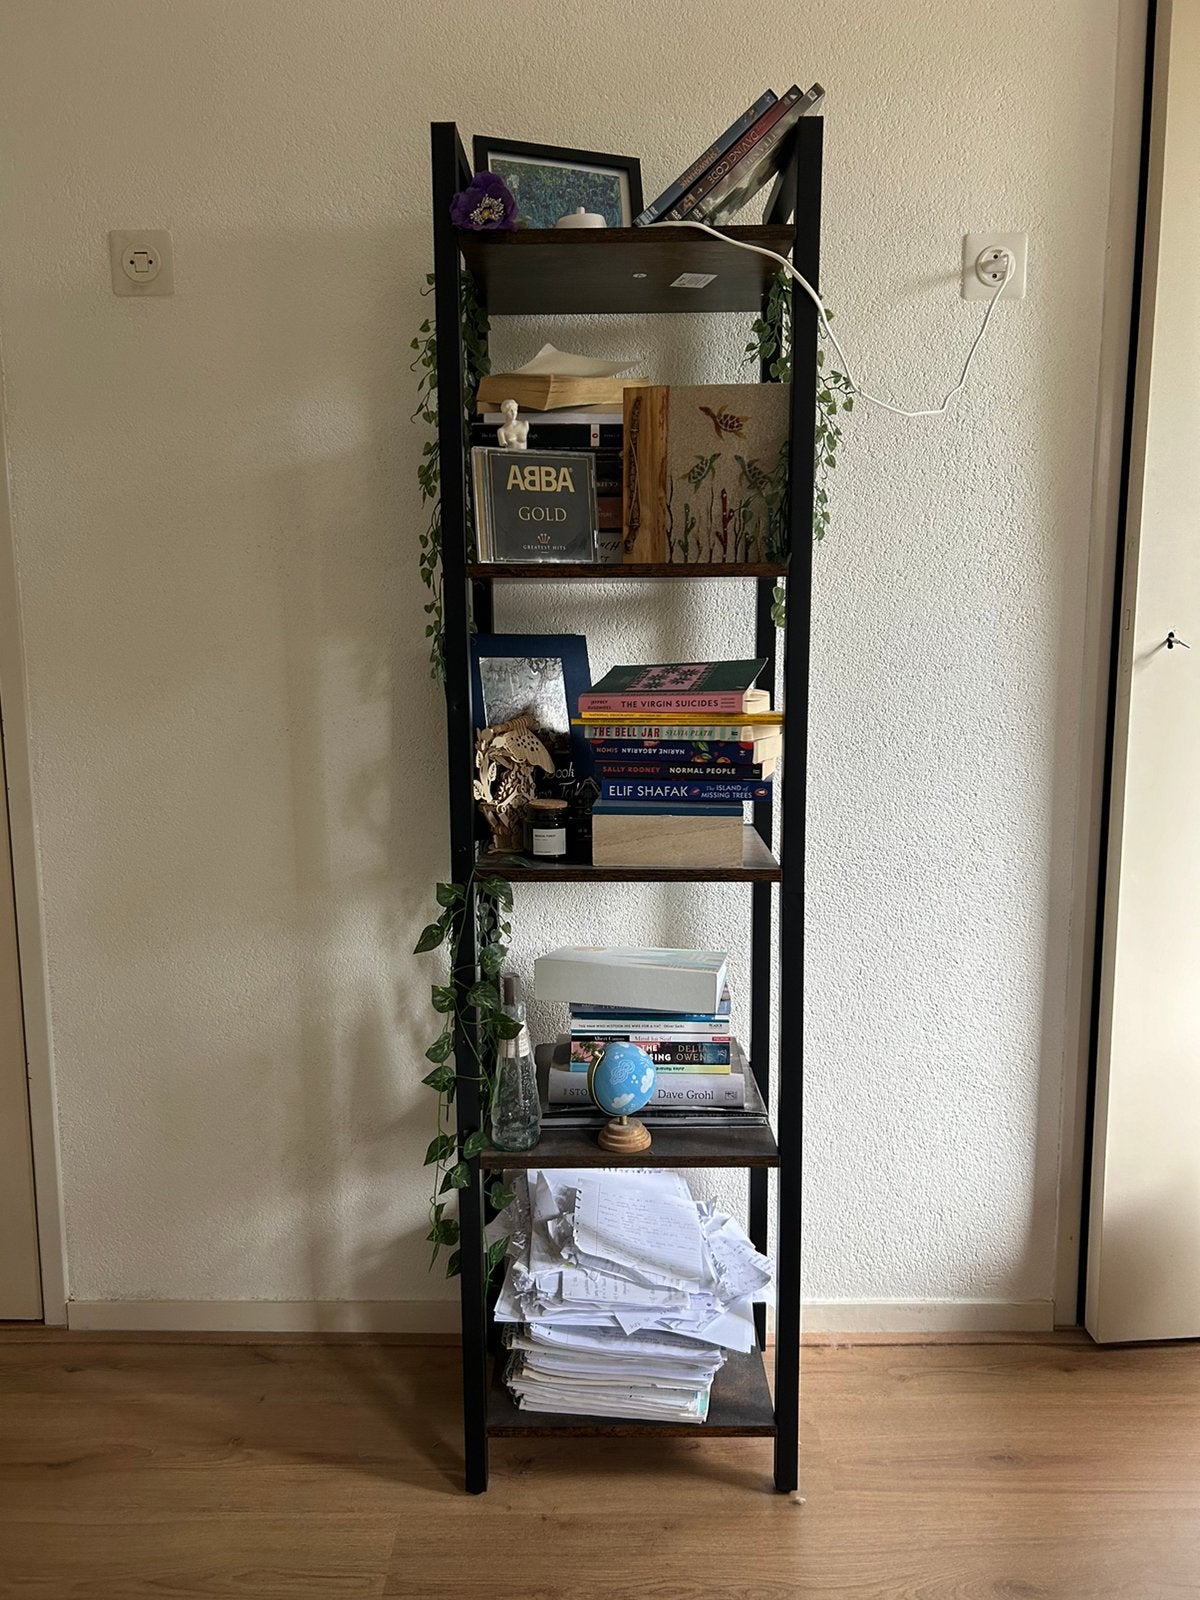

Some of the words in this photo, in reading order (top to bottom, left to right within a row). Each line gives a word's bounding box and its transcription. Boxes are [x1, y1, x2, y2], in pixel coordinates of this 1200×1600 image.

[679, 150, 718, 189] SHAWSHANK
[706, 160, 730, 184] CODE
[506, 464, 576, 493] ABBA
[518, 506, 567, 522] GOLD
[620, 700, 637, 708] THE
[640, 700, 672, 708] VIRGIN
[673, 699, 719, 708] SUICIDES
[593, 727, 611, 737] THE
[614, 727, 637, 737] BELL
[641, 727, 660, 738] JAR
[627, 766, 661, 774] ROONEY
[609, 785, 633, 796] ELIF
[637, 785, 689, 797] SHAFAK
[678, 1044, 708, 1052] DELIA
[676, 1053, 713, 1061] OWENS
[657, 1089, 683, 1099] Dave
[686, 1090, 714, 1100] Grohl
